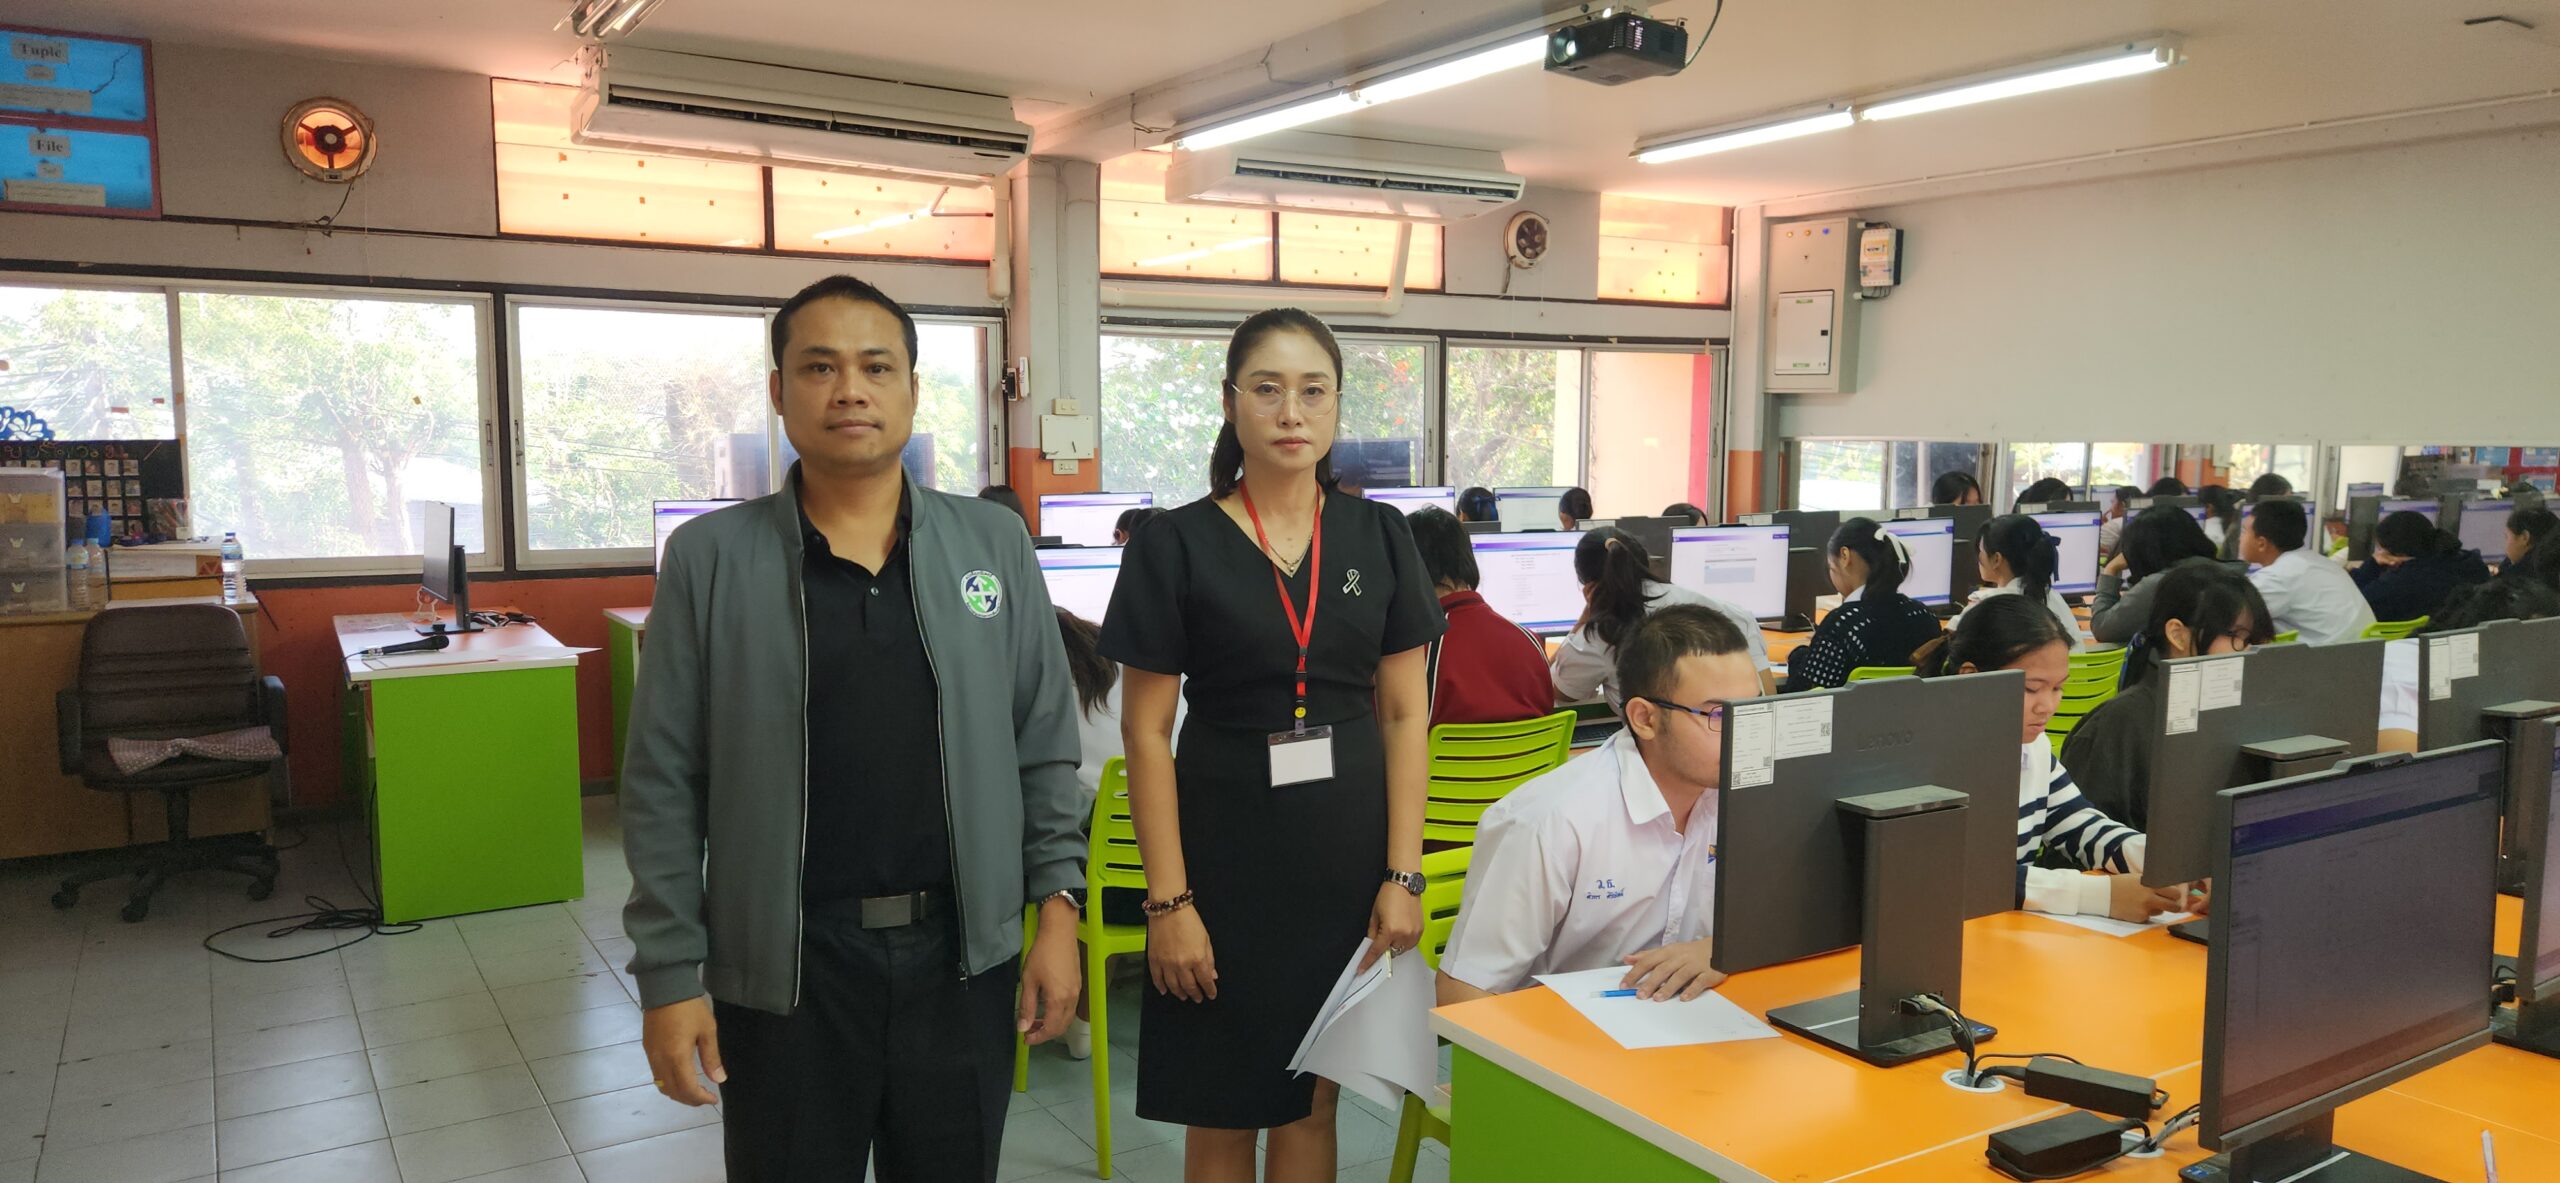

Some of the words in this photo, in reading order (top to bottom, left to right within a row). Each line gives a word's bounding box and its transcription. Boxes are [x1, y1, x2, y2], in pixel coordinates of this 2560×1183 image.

[20, 42, 63, 59] Tuple
[36, 139, 64, 153] File
[1857, 728, 1914, 752] Lenovo
